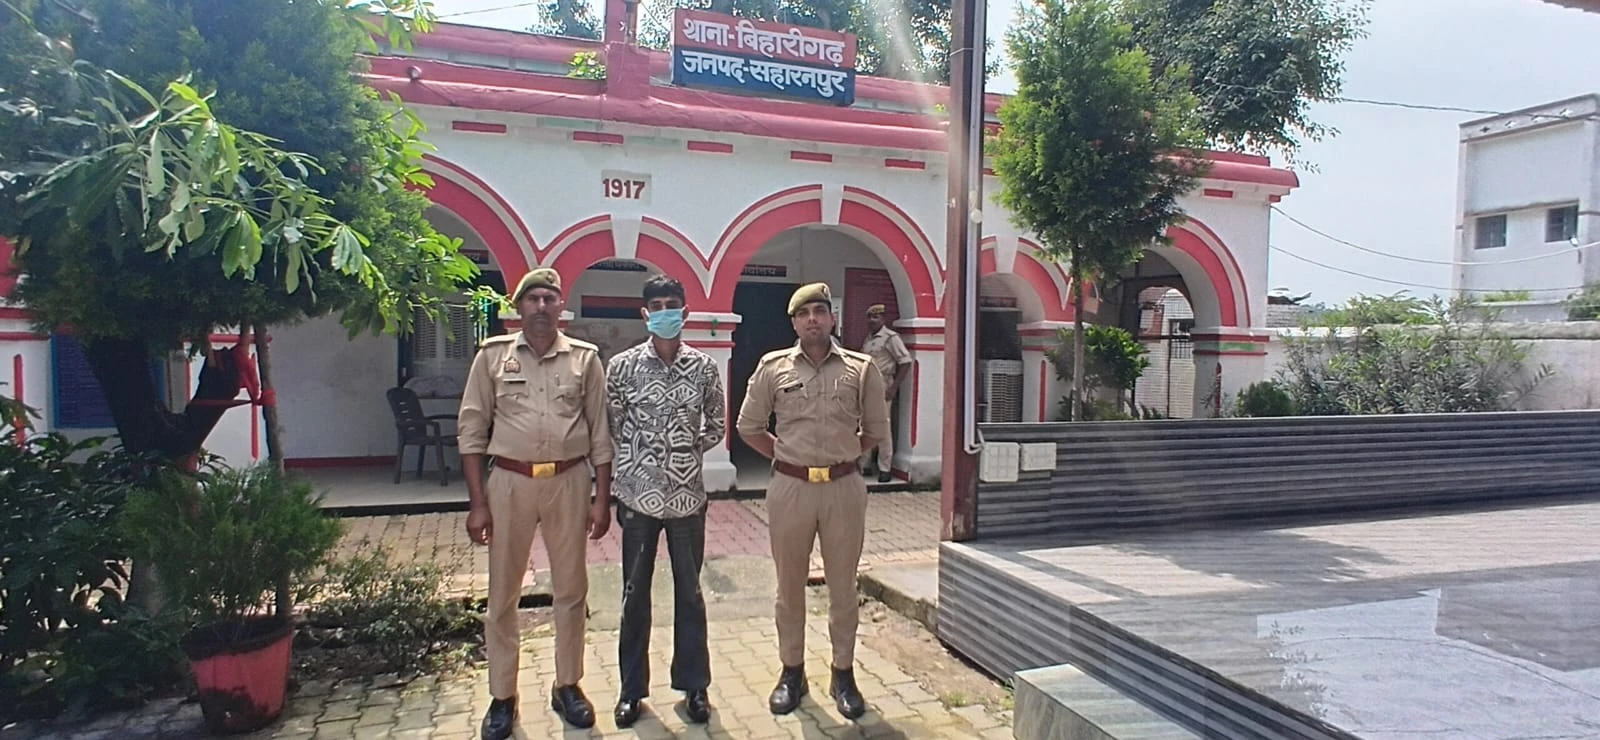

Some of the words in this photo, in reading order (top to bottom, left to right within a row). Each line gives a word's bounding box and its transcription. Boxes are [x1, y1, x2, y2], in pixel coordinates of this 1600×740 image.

[682, 18, 846, 68] थाना-बिहारीगढ़
[681, 50, 848, 98] जनपद-सहारनपुर
[602, 178, 646, 200] 1917
